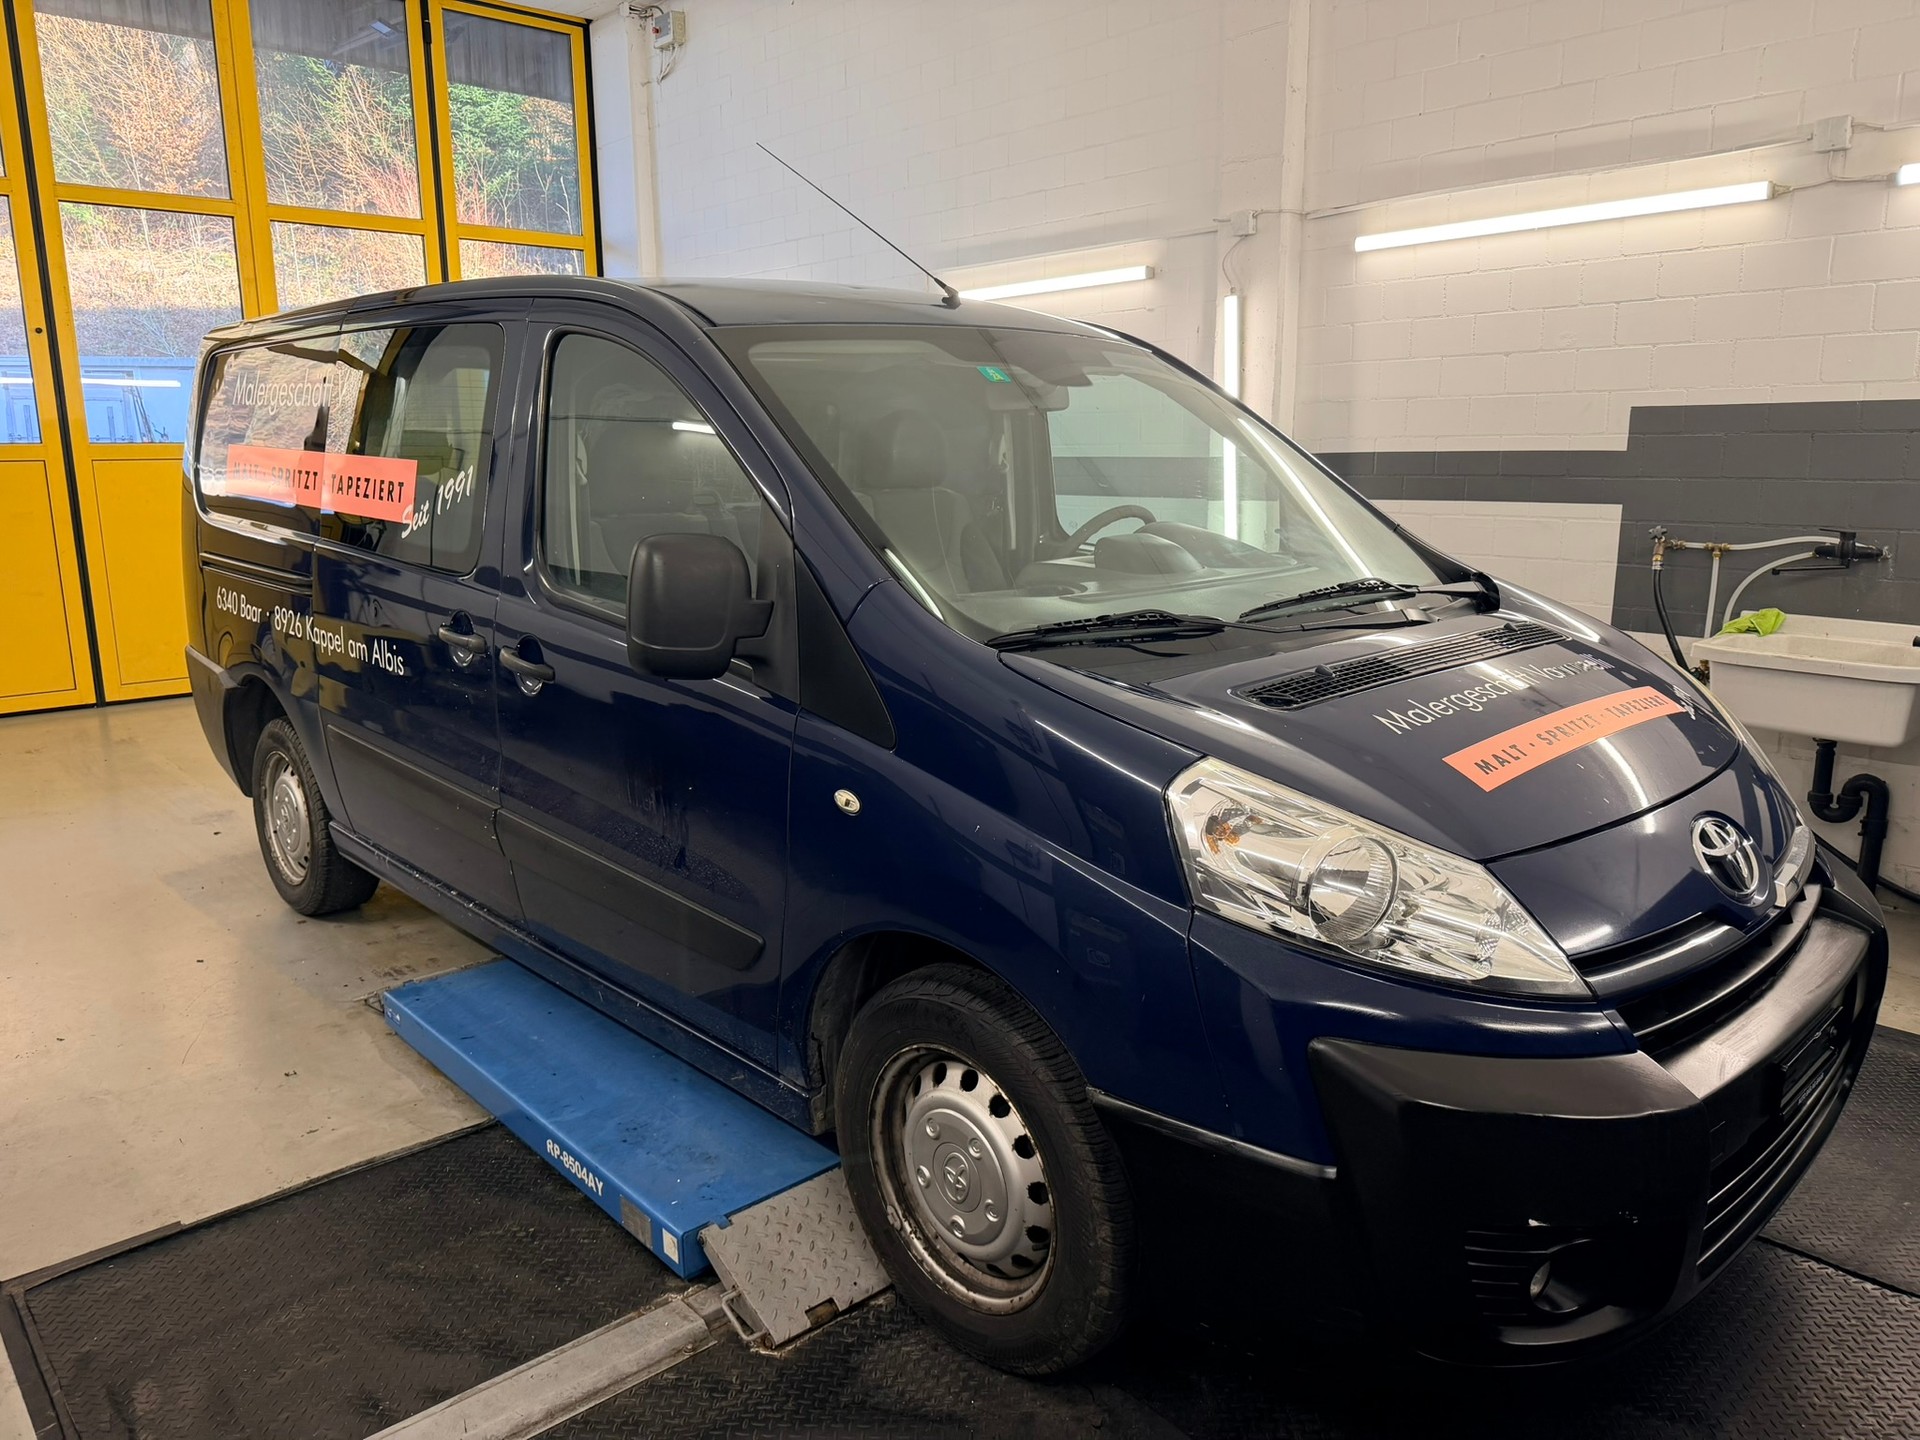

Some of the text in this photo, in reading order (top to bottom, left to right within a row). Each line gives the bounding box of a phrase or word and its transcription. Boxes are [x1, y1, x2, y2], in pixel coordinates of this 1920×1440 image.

[271, 466, 319, 491] SPRITZT
[331, 474, 405, 504] TAPEZIERT
[401, 465, 474, 539] Seit 1991
[216, 585, 405, 676] 6340 Baar 8926 Kappel am Albis
[1372, 667, 1541, 735] Malergeschft
[1473, 743, 1528, 775] MALT
[1535, 713, 1600, 746] SPRITZT
[1605, 694, 1669, 719] TAPEZIERT
[545, 1139, 604, 1197] RP-8504AY
